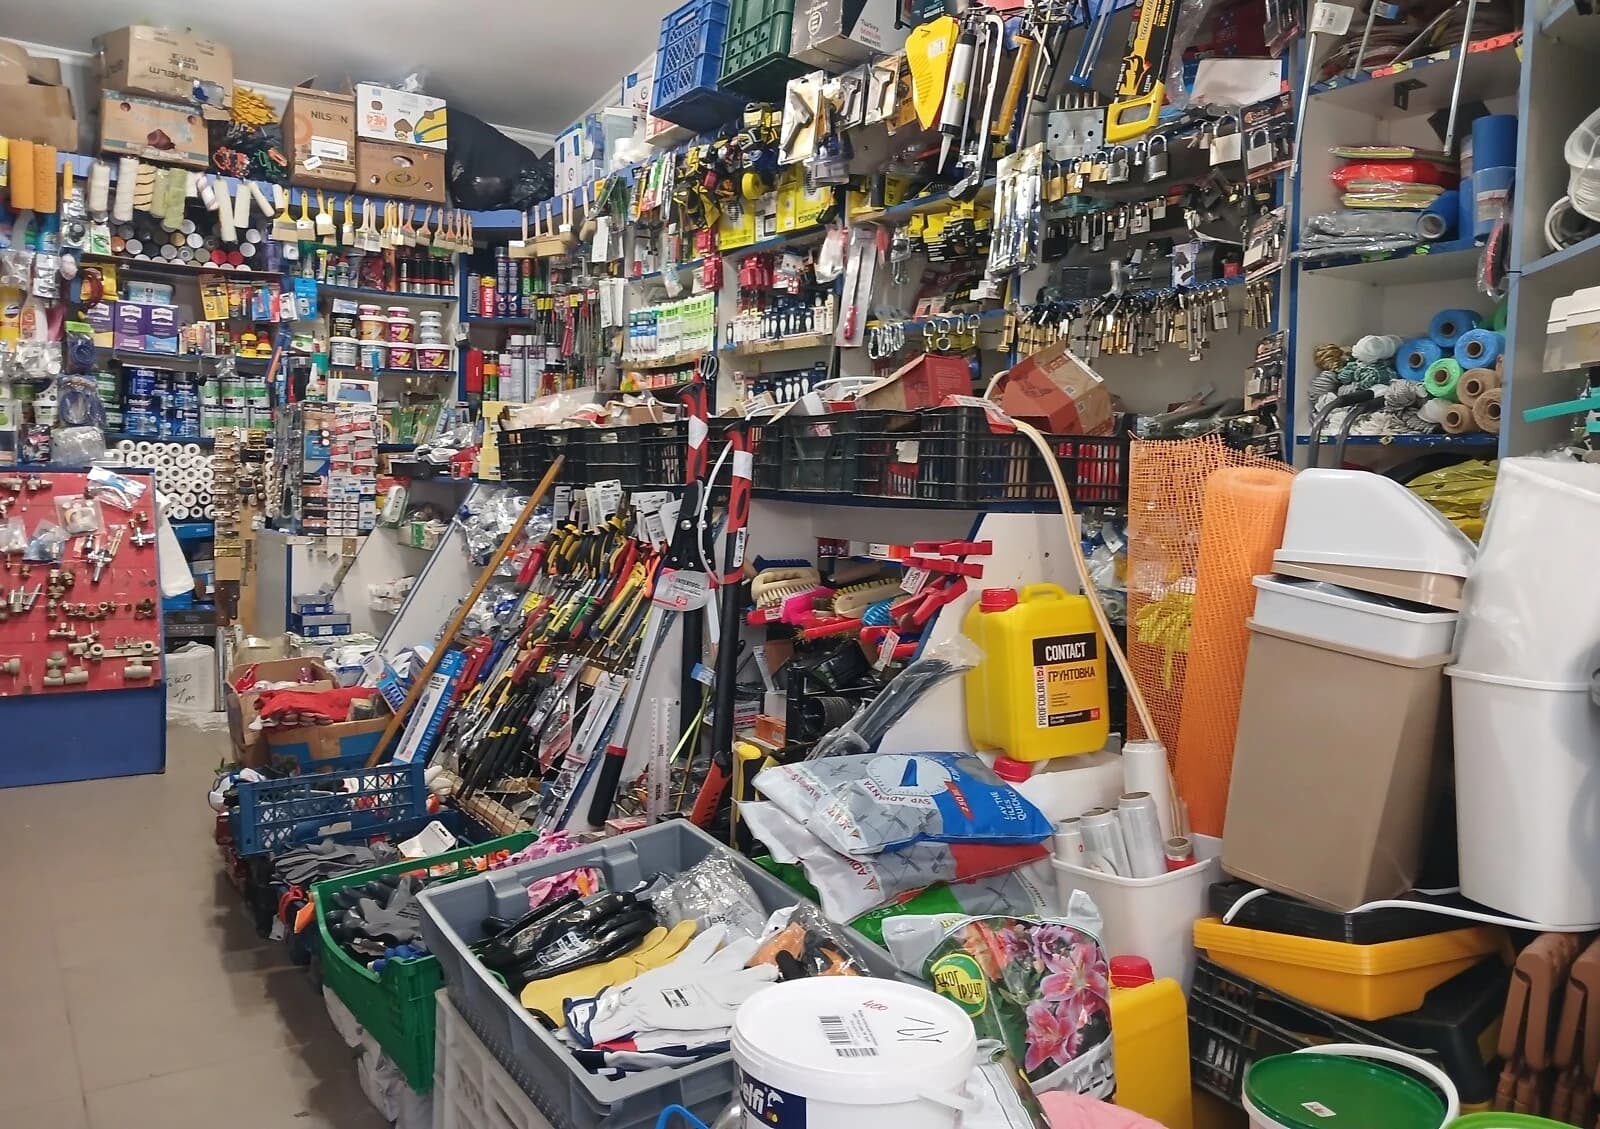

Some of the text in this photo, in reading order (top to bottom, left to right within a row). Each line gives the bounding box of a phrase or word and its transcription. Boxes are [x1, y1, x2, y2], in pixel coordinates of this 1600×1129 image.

[311, 110, 348, 124] NILSN
[1045, 642, 1086, 661] CONTACT
[1048, 666, 1096, 683] ГРУНТОВКА
